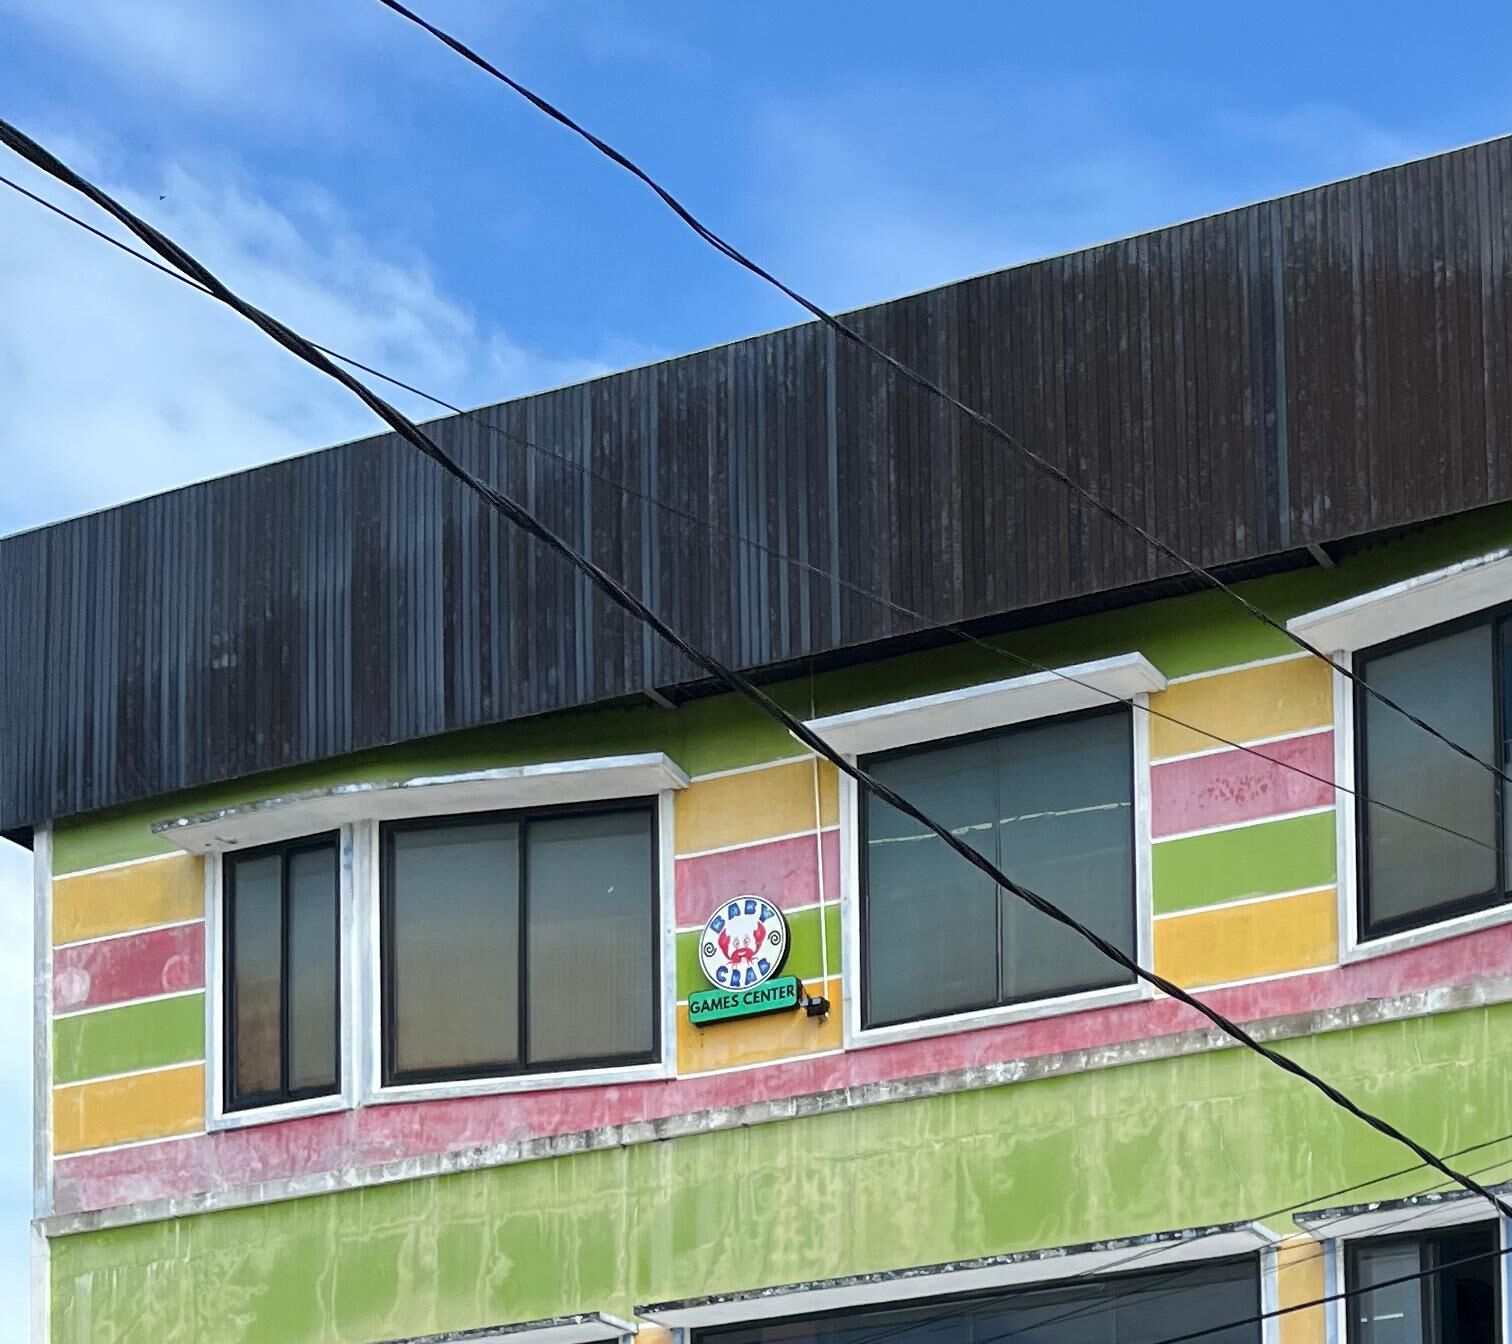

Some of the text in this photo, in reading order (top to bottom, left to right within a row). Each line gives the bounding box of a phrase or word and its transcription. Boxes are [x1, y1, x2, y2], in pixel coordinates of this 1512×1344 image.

[710, 899, 774, 934] BABY
[716, 958, 771, 987] CRAB
[690, 985, 795, 1014] GAMES CENTER
